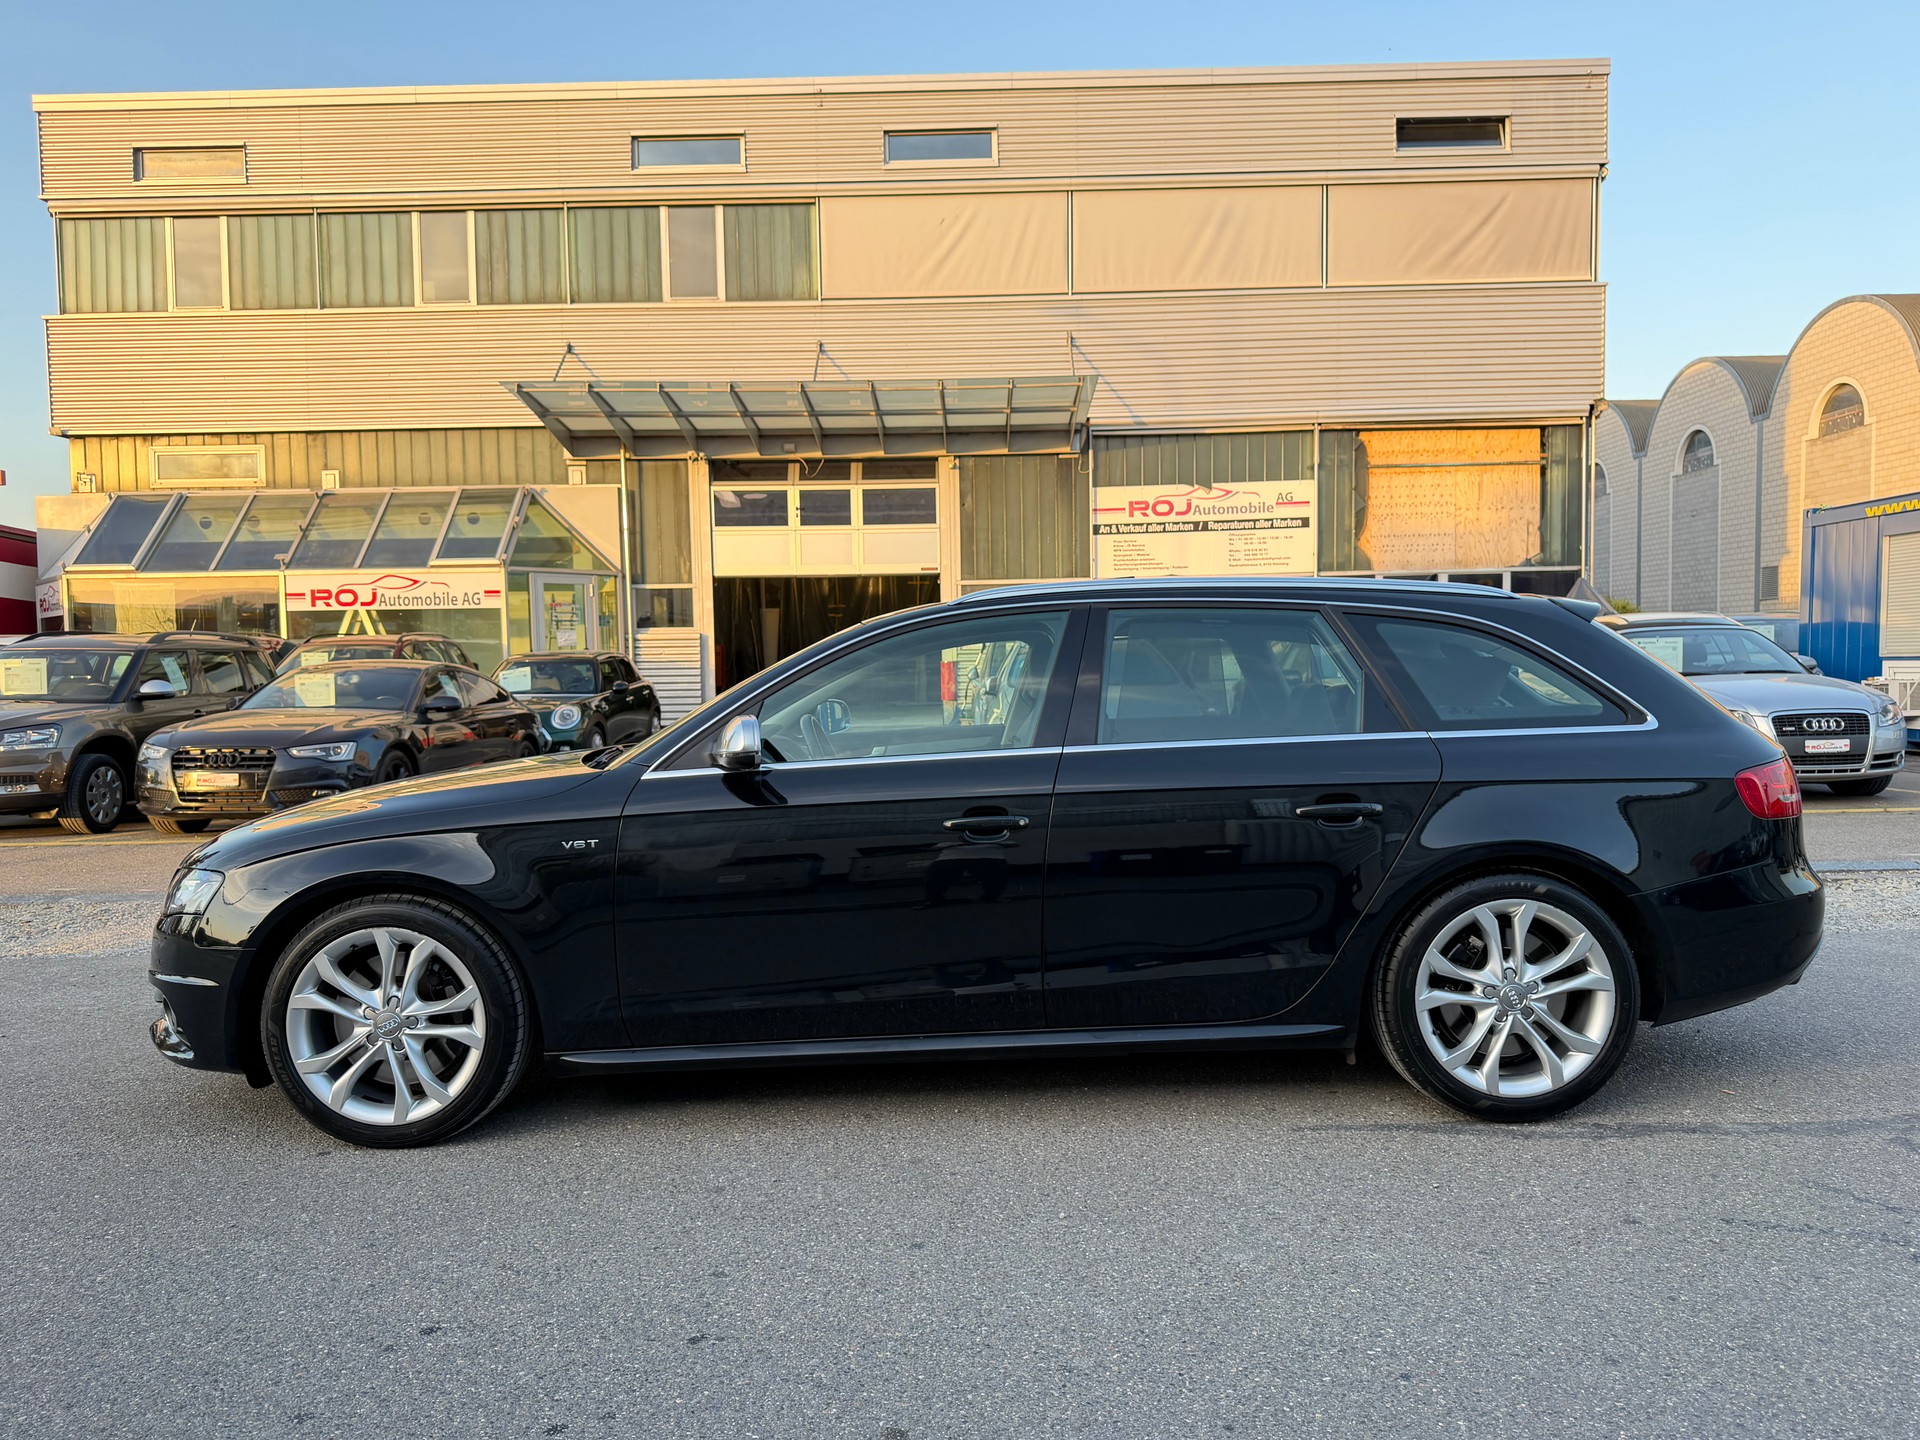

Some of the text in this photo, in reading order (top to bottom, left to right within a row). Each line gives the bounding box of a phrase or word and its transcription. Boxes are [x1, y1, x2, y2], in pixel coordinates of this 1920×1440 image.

[1128, 492, 1294, 517] ROJ Automobile AG
[1099, 524, 1110, 534] An
[1111, 524, 1117, 533] &
[1117, 523, 1147, 533] Verkauf
[1147, 522, 1164, 532] aller
[1165, 522, 1193, 532] Marken
[1208, 520, 1254, 532] Reparaturen
[1255, 519, 1272, 529] aller
[1273, 518, 1302, 528] Marken
[310, 588, 481, 607] ROJ Automobile AG
[561, 839, 599, 849] V6T
